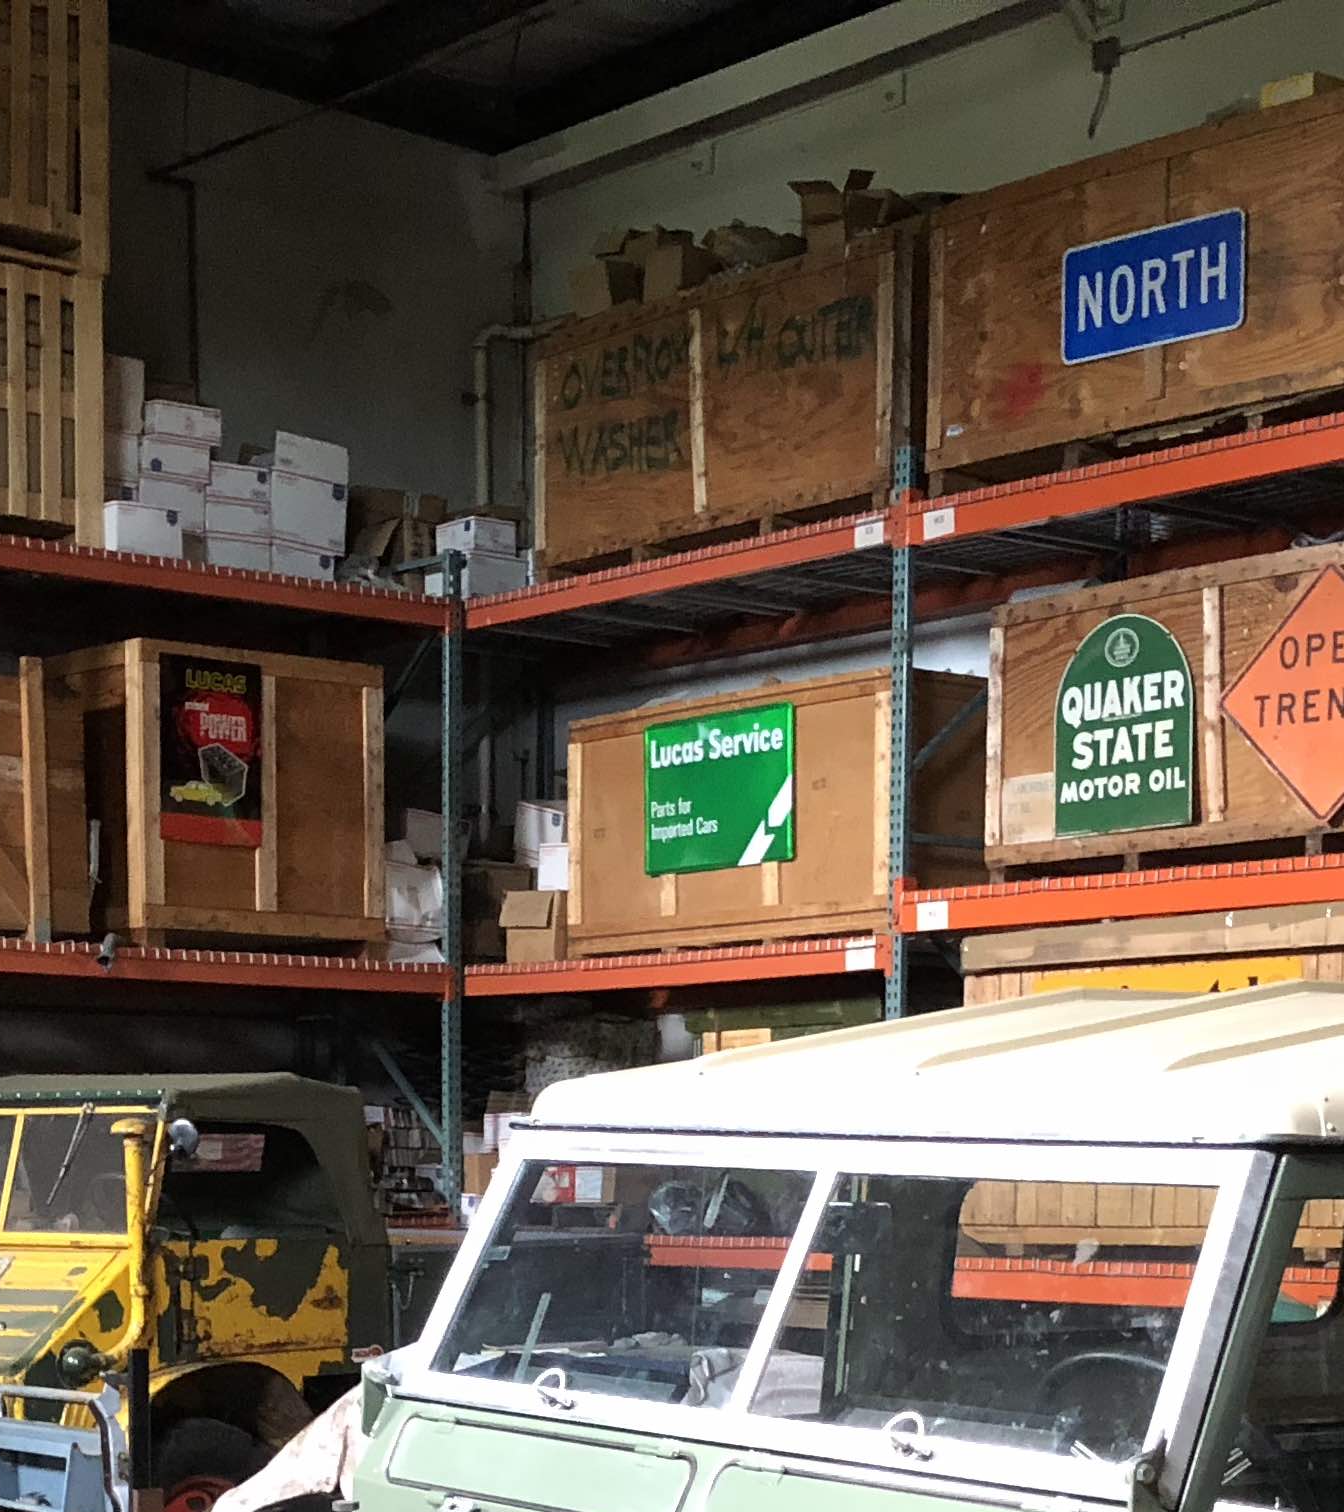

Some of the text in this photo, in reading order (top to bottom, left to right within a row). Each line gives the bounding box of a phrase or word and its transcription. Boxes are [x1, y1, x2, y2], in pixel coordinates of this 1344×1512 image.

[1076, 241, 1228, 333] NORTH
[184, 667, 248, 695] LUCAS
[1061, 669, 1186, 729] QUAKER
[198, 711, 248, 743] POWER
[650, 722, 784, 769] Lucas Service
[1071, 718, 1175, 771] STATE
[1059, 772, 1142, 805] MOTOR
[1148, 766, 1186, 793] OIL
[650, 796, 692, 819] Parts for
[650, 816, 719, 844] Imported Cars
